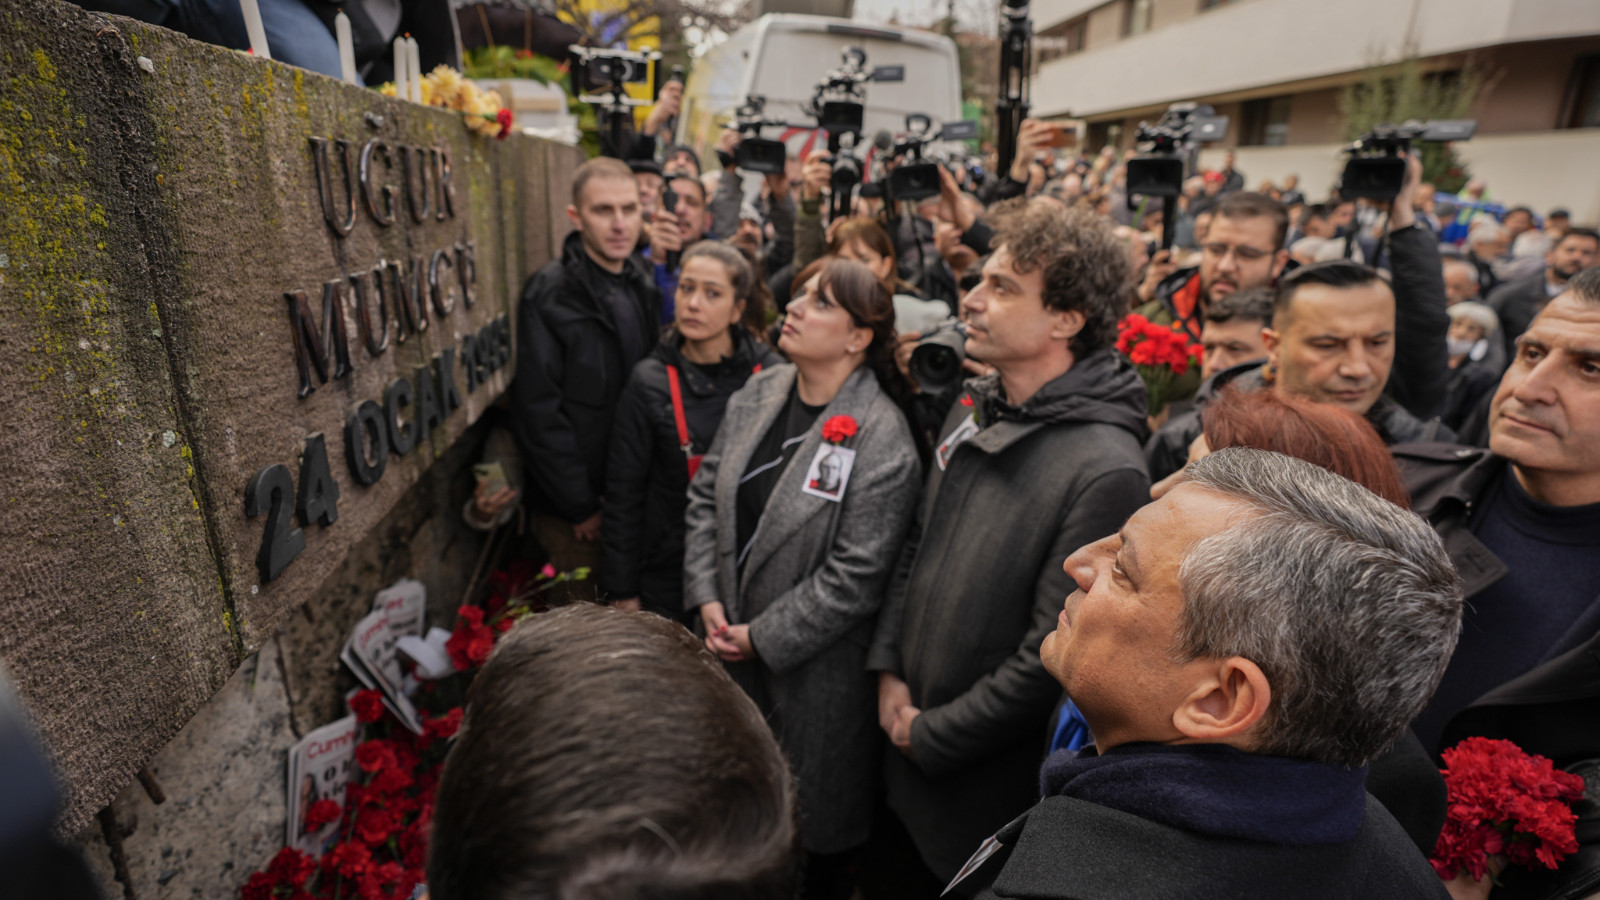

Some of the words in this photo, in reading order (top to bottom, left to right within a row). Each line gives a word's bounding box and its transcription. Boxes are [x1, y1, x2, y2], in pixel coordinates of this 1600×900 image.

[284, 243, 477, 399] MUMCU
[245, 431, 341, 583] 24
[345, 347, 461, 486] OCAK
